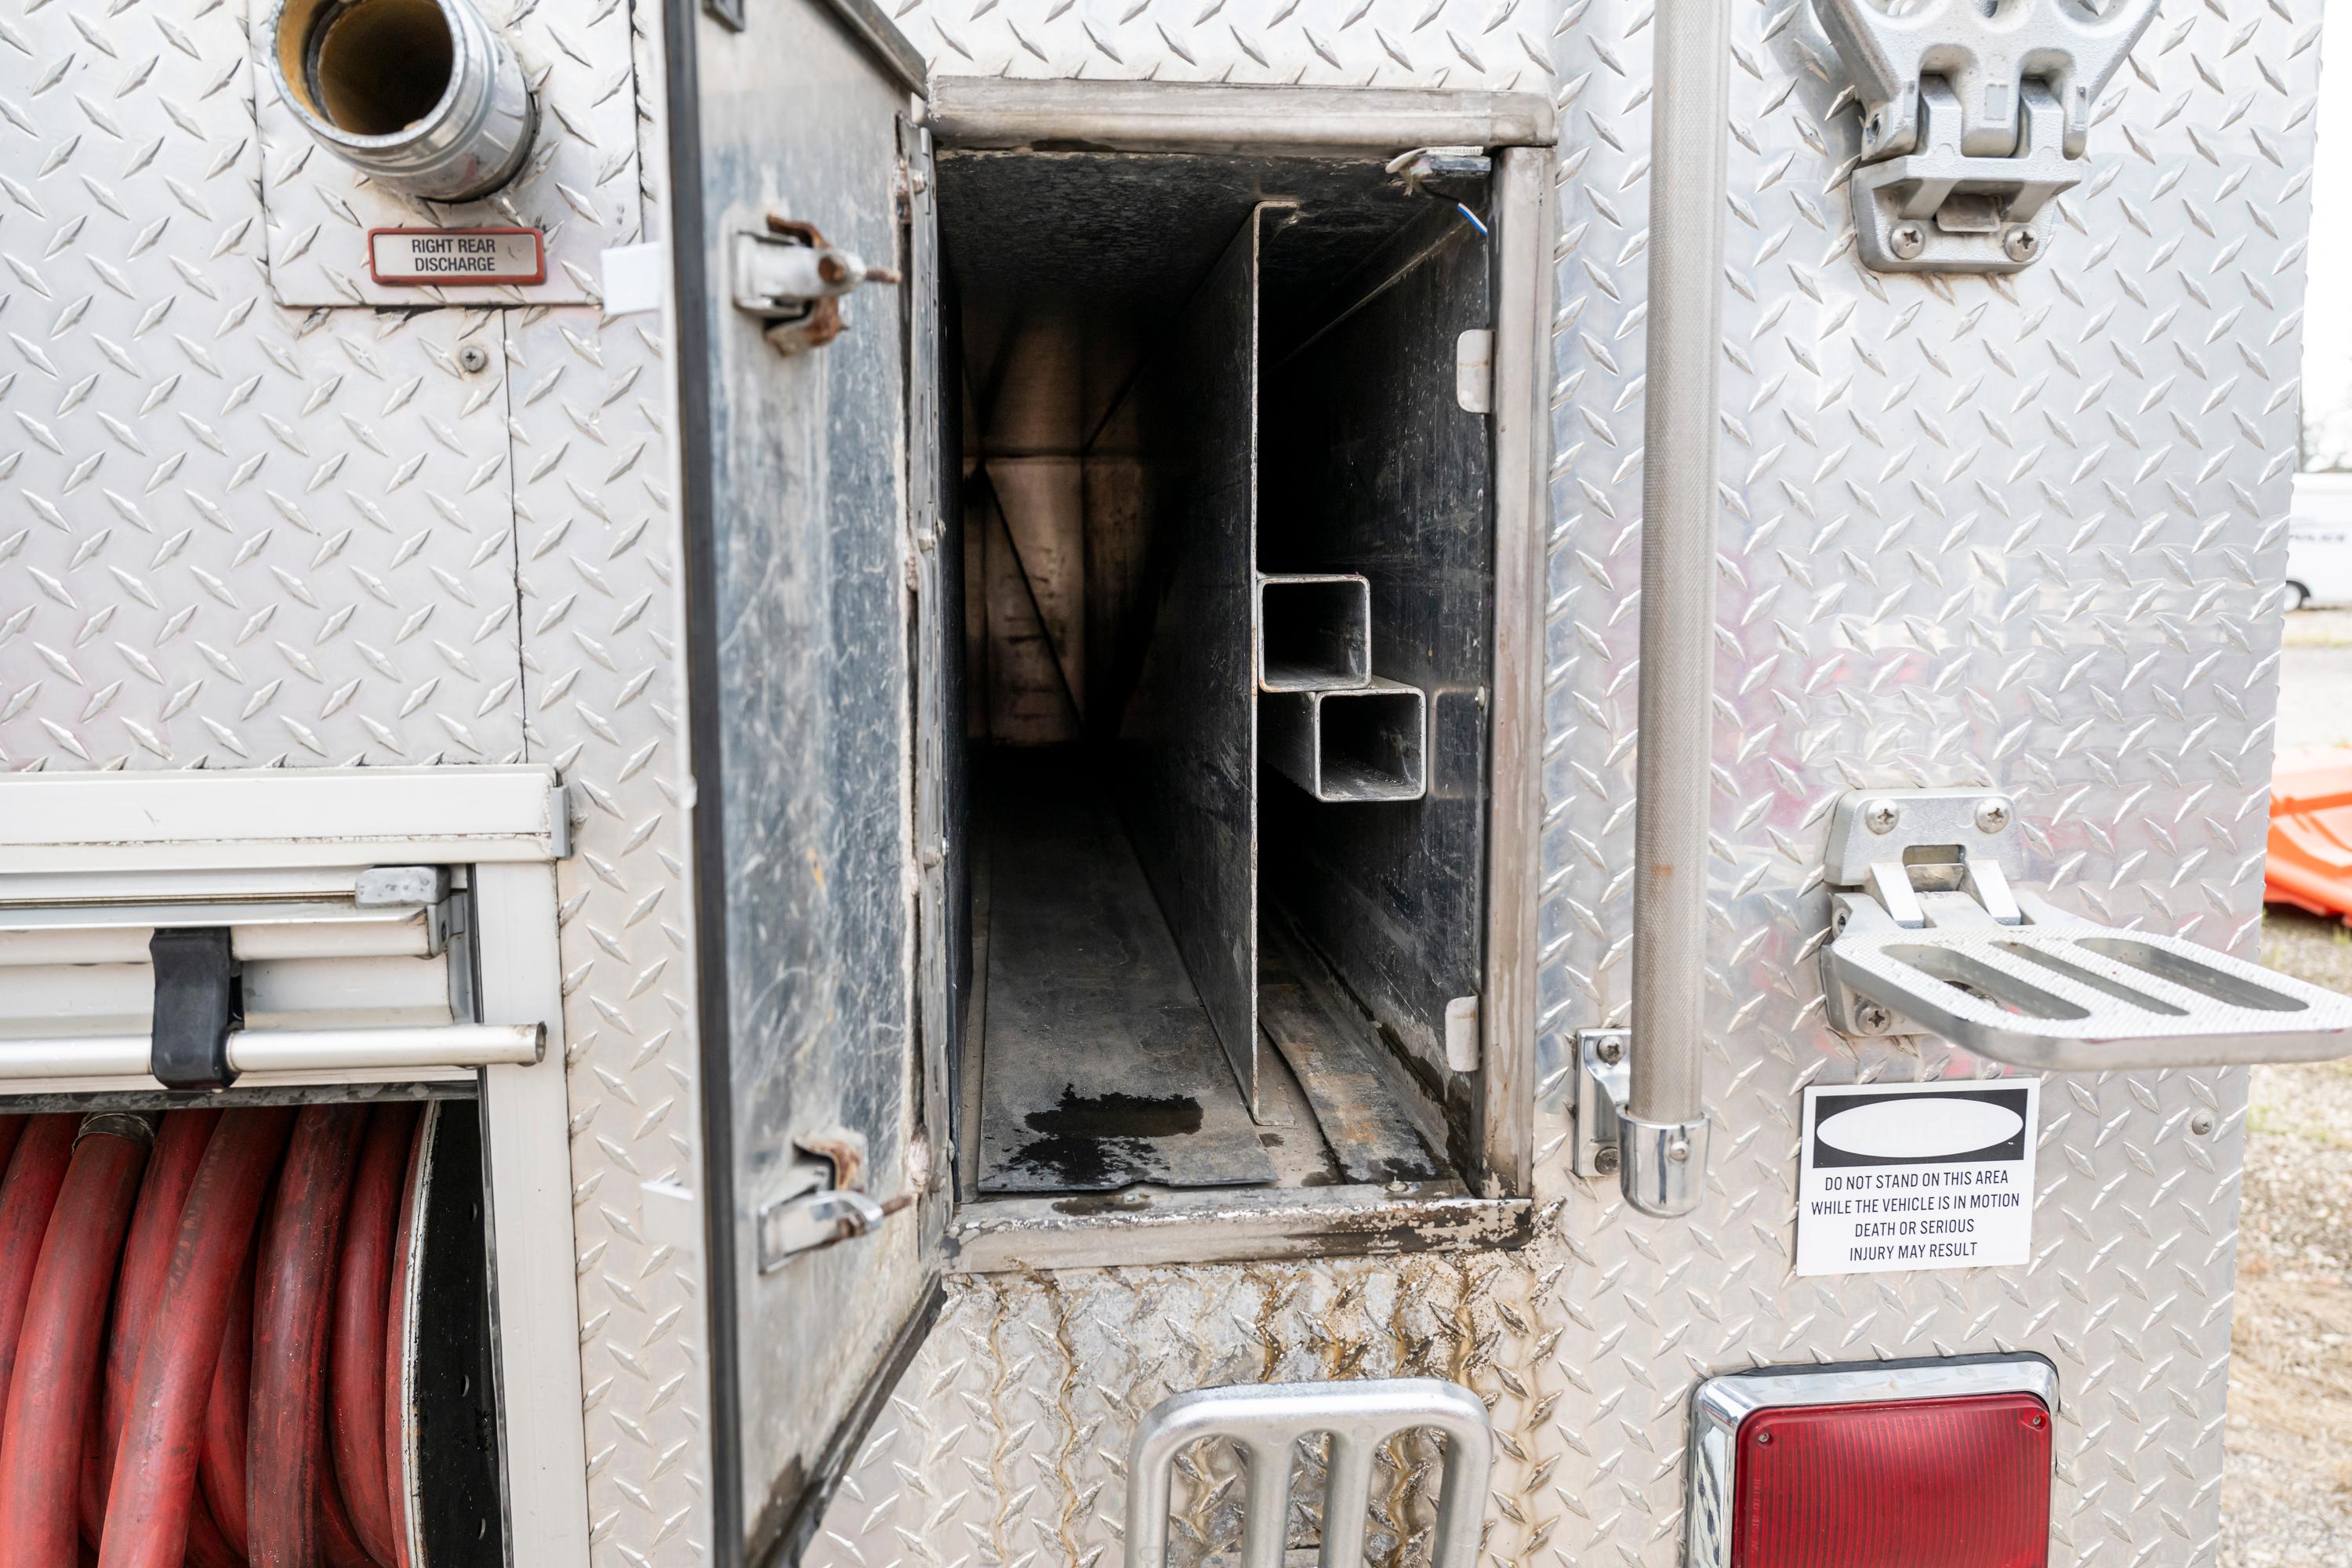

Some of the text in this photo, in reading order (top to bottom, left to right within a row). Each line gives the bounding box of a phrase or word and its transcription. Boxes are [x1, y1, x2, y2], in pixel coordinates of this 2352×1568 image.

[412, 238, 495, 253] RIGHT REAR
[415, 257, 495, 271] DISCHARGE
[1824, 1170, 2009, 1191] DO NOT STAND ON THIS AREA
[1811, 1192, 2020, 1215] WHILE THE VEHICLE IS IN MOTION
[1855, 1218, 1975, 1237] DEATH OR SERIOUS
[1849, 1242, 1978, 1261] INJURY MAY RESULT
